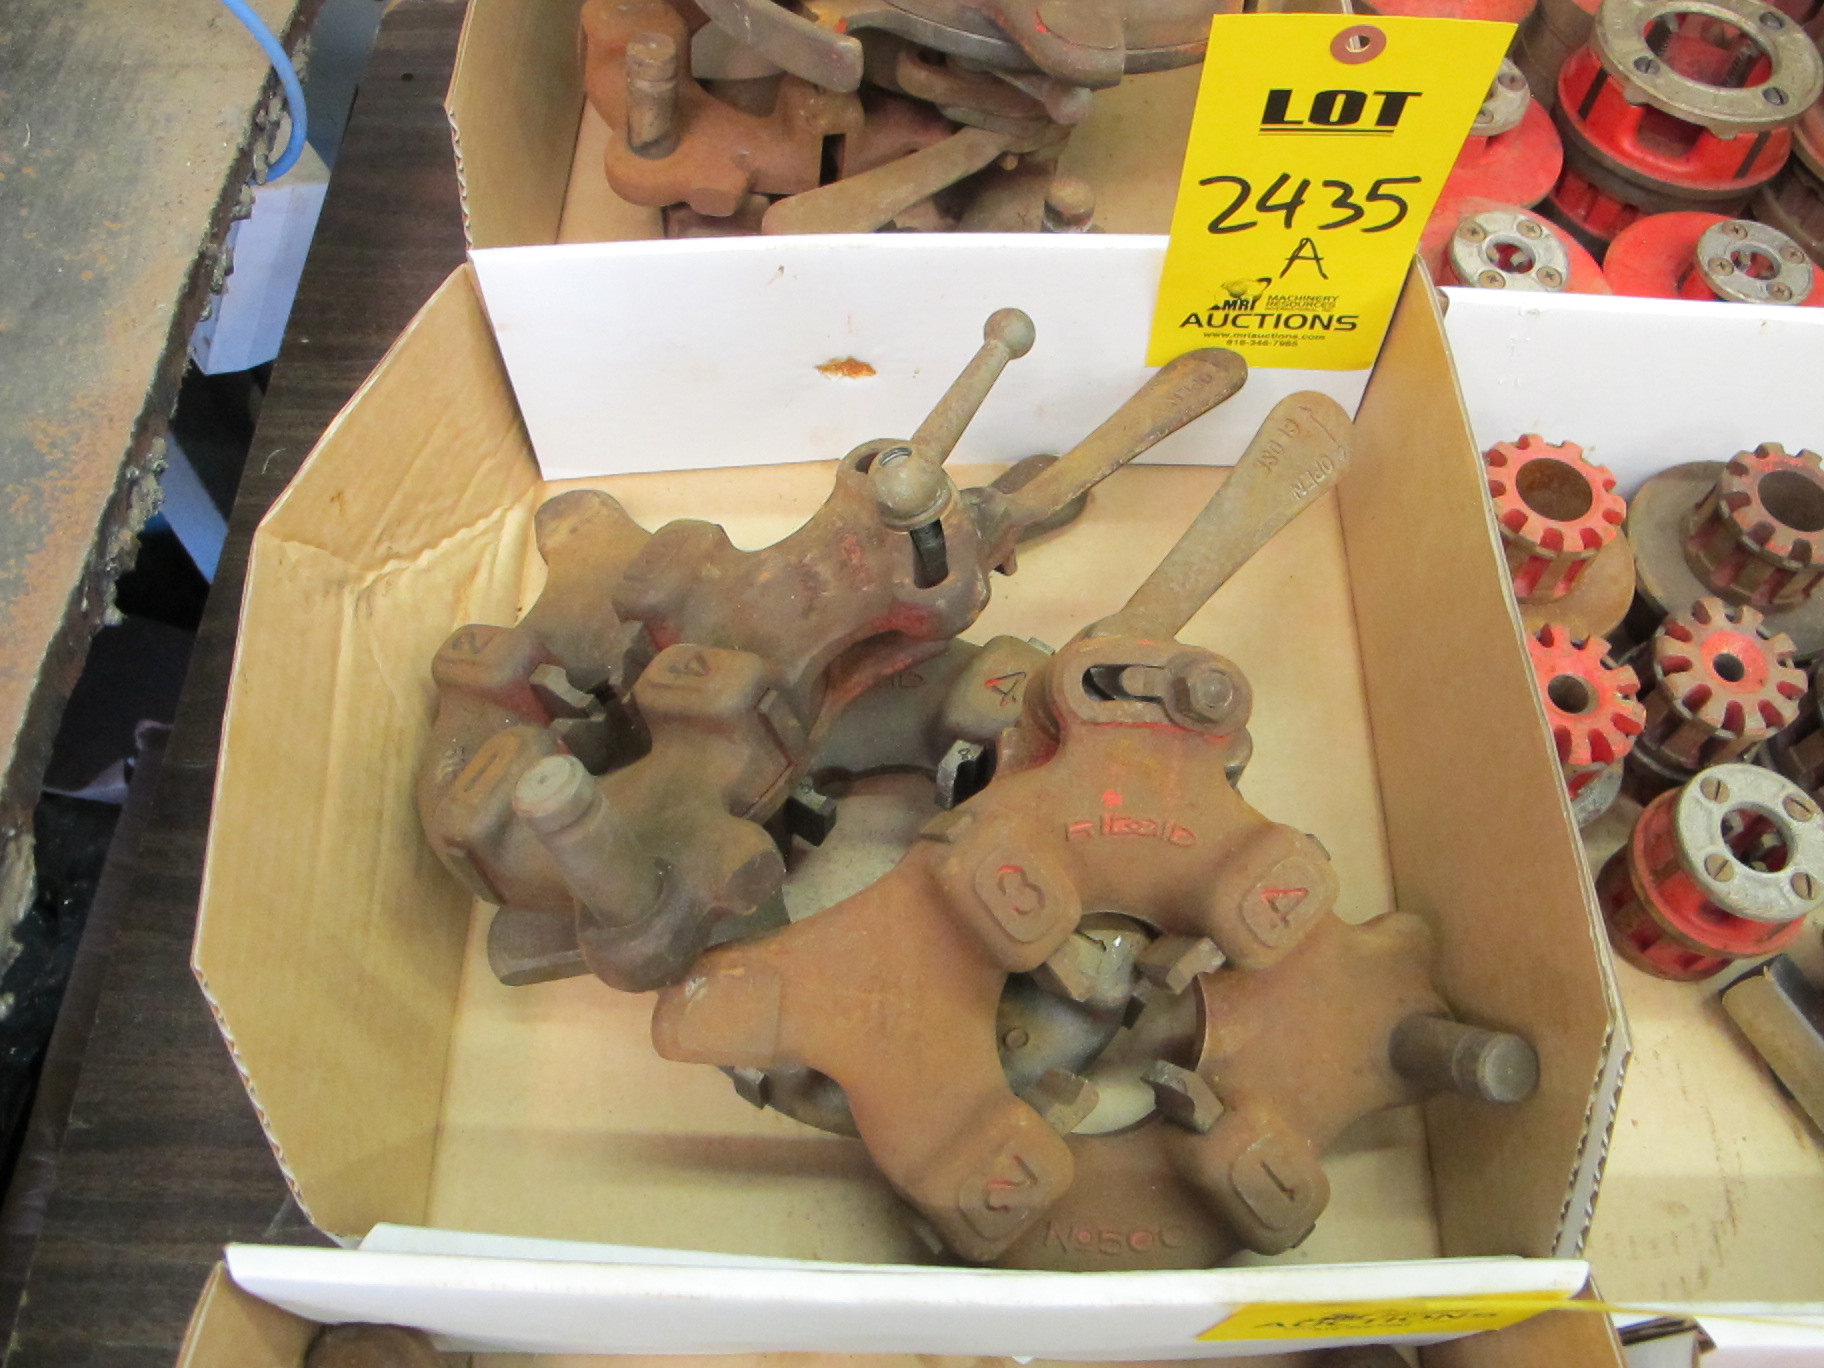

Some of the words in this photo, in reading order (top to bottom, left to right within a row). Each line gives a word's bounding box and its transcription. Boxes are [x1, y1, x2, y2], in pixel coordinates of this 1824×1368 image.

[1261, 89, 1423, 127] LOT
[1198, 172, 1422, 234] 2435
[1279, 237, 1329, 279] A
[1179, 313, 1360, 331] AUCTIONS
[1221, 298, 1259, 311] MRI
[996, 865, 1046, 916] 3
[1260, 887, 1309, 929] 4
